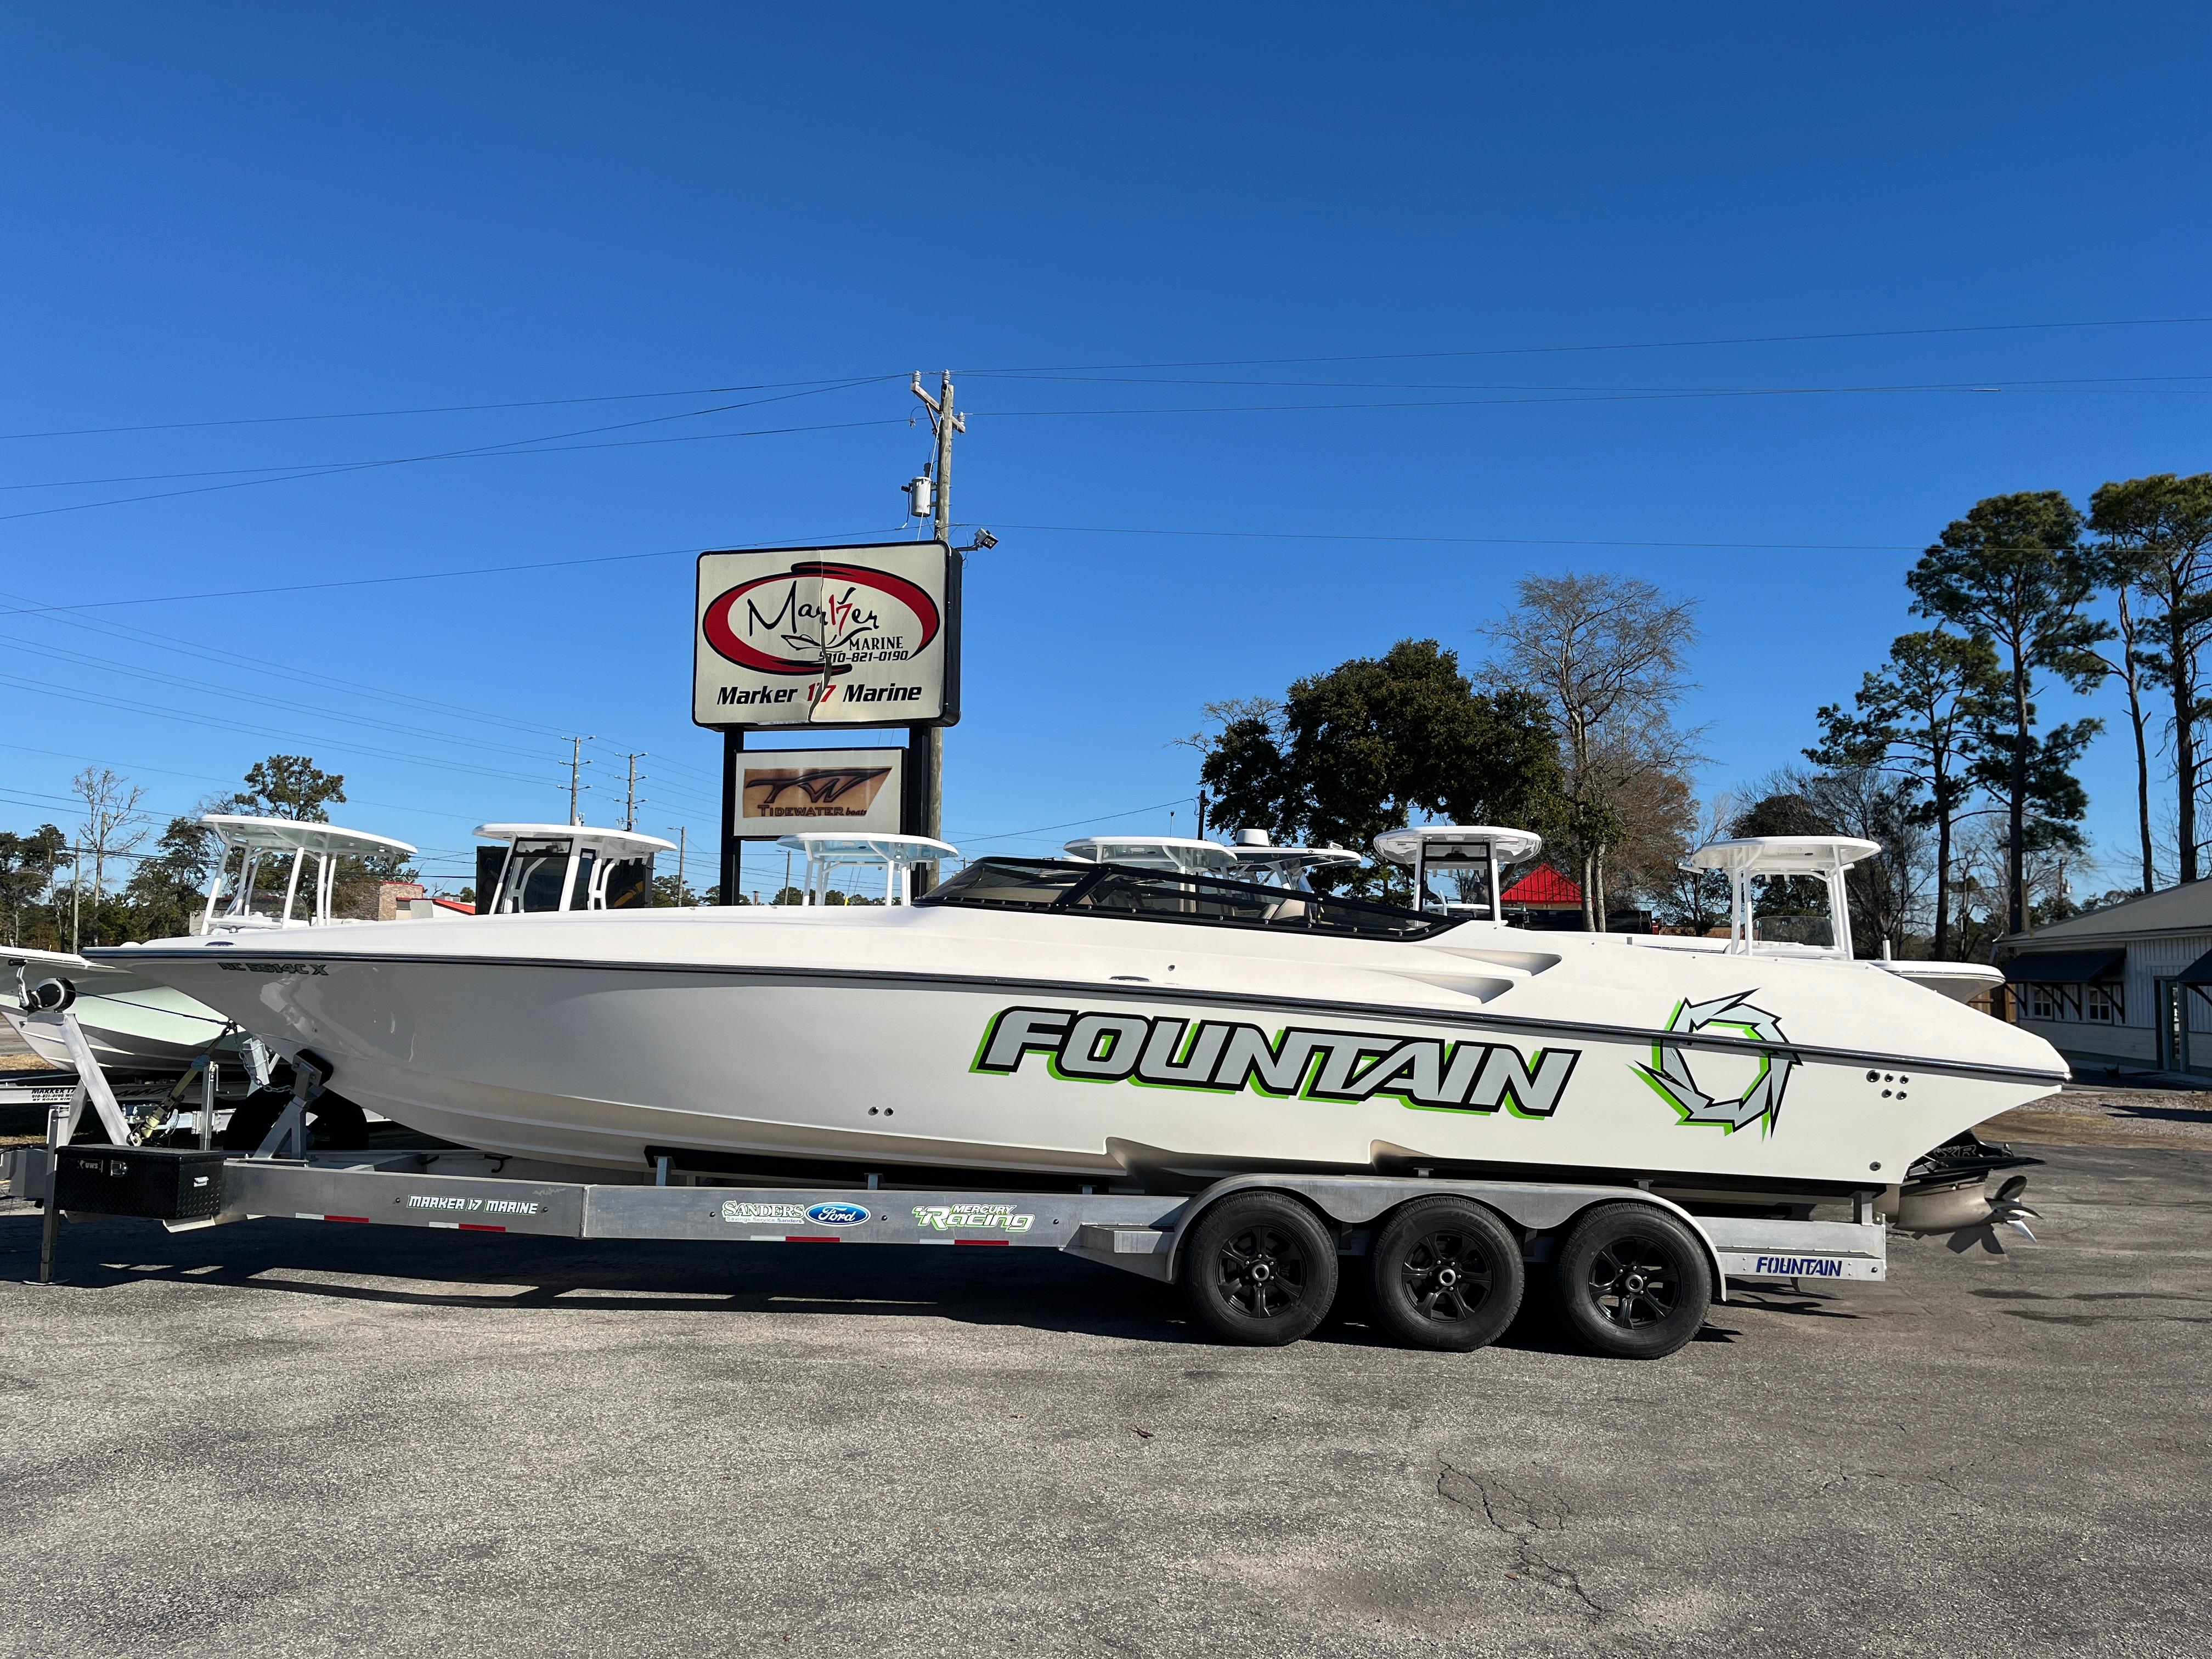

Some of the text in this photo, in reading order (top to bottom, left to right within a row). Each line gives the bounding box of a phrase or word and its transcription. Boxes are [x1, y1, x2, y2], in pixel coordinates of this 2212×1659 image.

[849, 636, 904, 651] MARINE
[717, 682, 922, 705] Marker 17 Marine
[758, 805, 844, 816] TIDEWATER
[970, 1006, 1582, 1119] FOUNTAIN
[407, 1195, 539, 1215] MARKER 17 MARINE
[723, 1201, 856, 1222] SANDERS Ford
[952, 1205, 1016, 1214] MERCURY
[1756, 1256, 1842, 1277] FOUNTAIN
